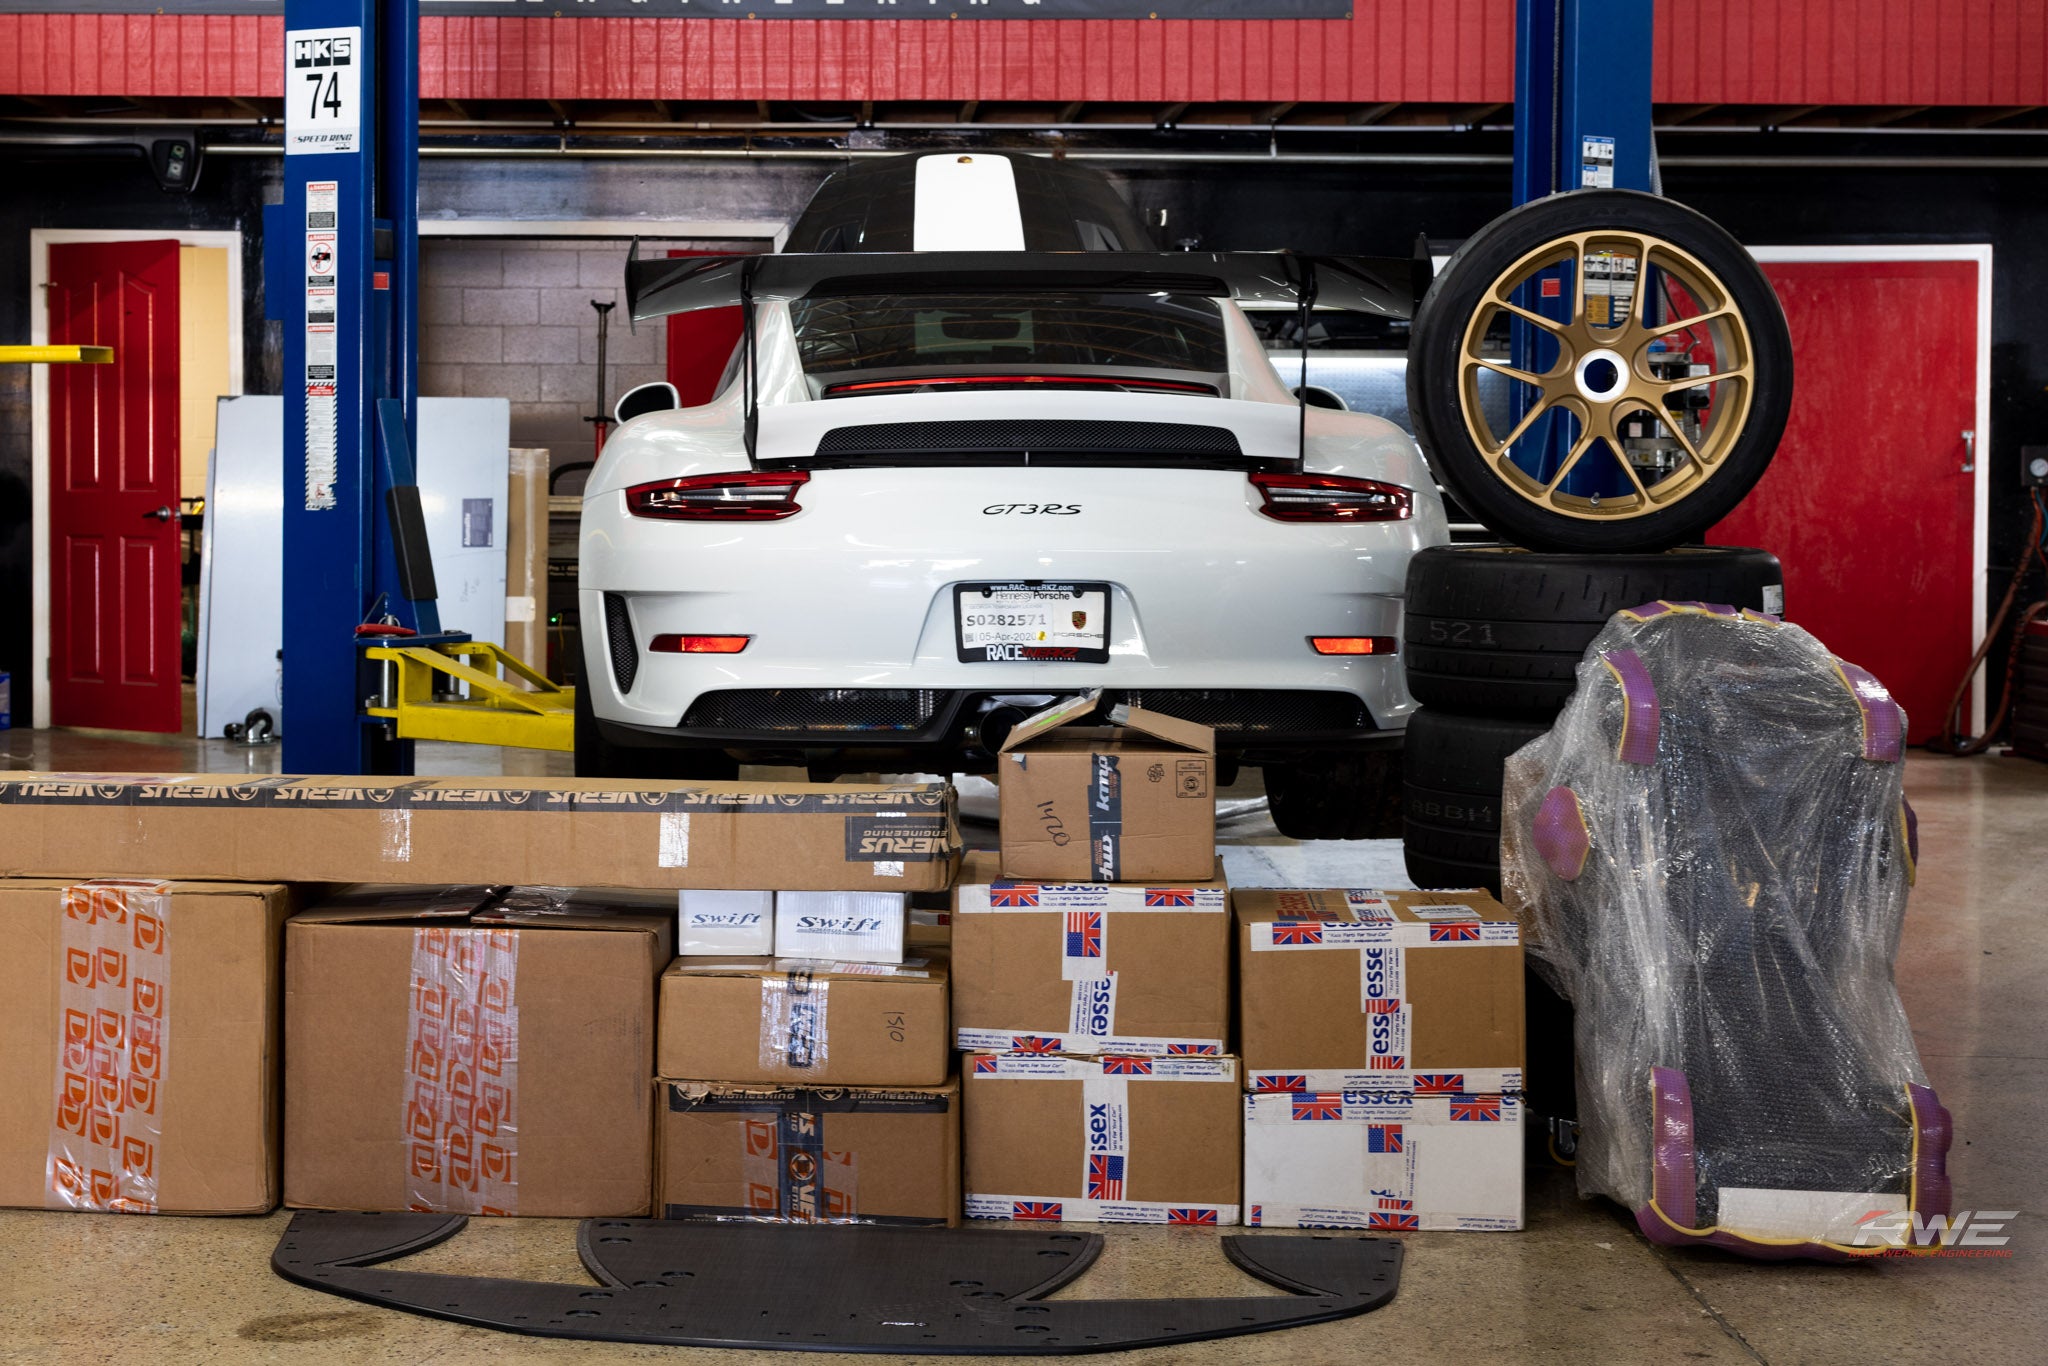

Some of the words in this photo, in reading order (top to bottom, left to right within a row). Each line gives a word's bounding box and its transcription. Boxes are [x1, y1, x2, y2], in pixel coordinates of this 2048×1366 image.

[295, 37, 351, 67] HKS
[306, 71, 342, 119] 74
[297, 135, 328, 143] SPEED
[329, 133, 353, 141] RING
[1033, 591, 1070, 600] Porsche
[966, 614, 1047, 626] S0282571
[1096, 755, 1113, 811] kmp
[863, 829, 949, 837] ENGINEERING
[858, 837, 950, 854] VERUS
[691, 913, 761, 925] Swift
[796, 916, 883, 931] Swift
[1366, 948, 1383, 997] esse
[1373, 1013, 1389, 1054] ess
[1090, 1104, 1107, 1150] sex
